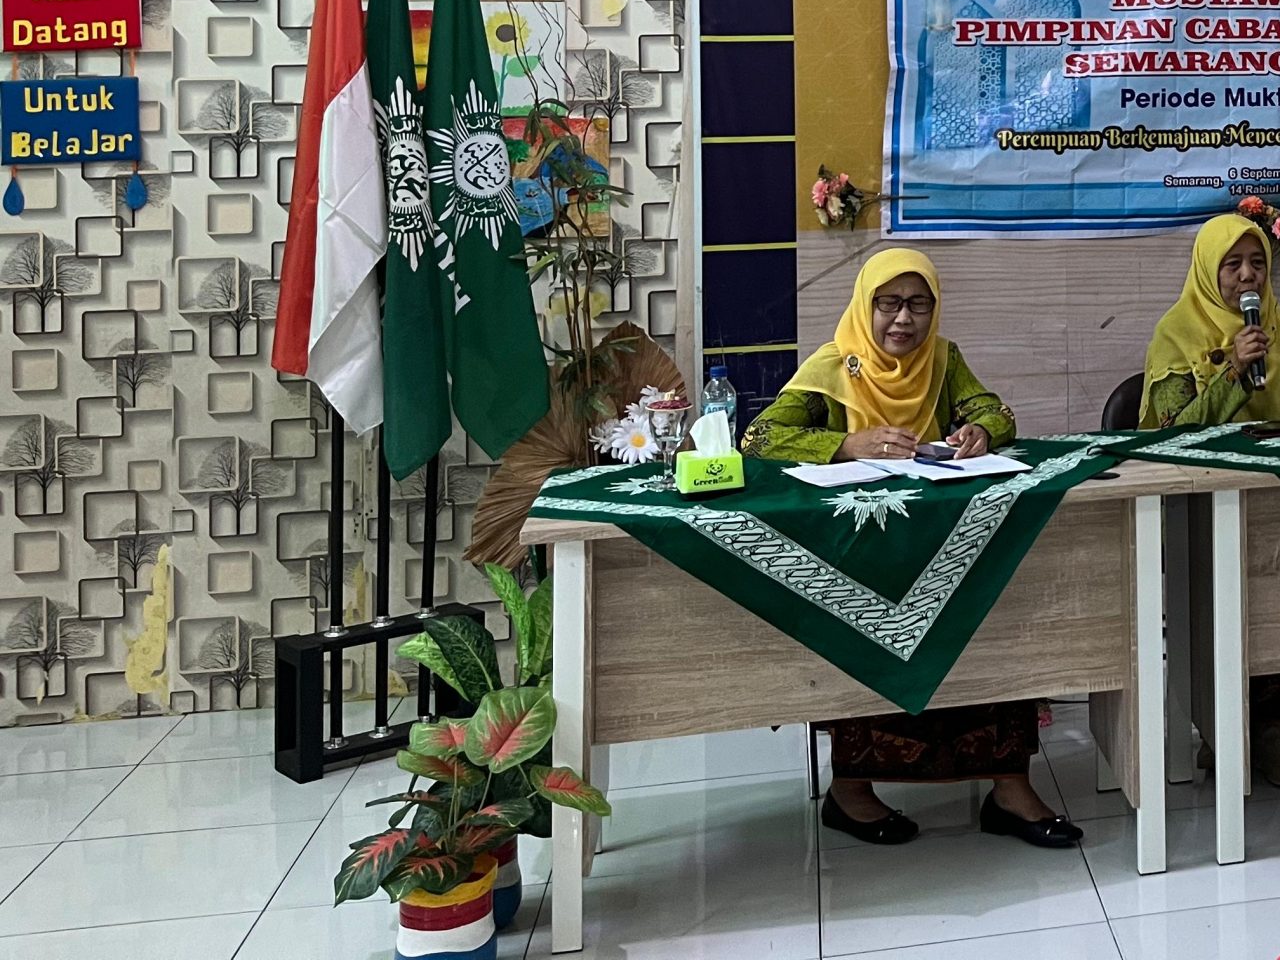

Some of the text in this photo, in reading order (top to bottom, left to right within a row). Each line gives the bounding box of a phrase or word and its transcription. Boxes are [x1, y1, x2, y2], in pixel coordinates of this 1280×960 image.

[13, 17, 128, 46] Datang
[955, 18, 1175, 43] PIMPINAN
[24, 86, 114, 113] Untuk
[1121, 88, 1215, 109] Periode
[997, 129, 1101, 153] Perempuan
[1105, 126, 1222, 150] Berkemajuan
[1164, 176, 1224, 187] Semarang,
[1229, 168, 1237, 179] 6
[1230, 185, 1243, 195] 14
